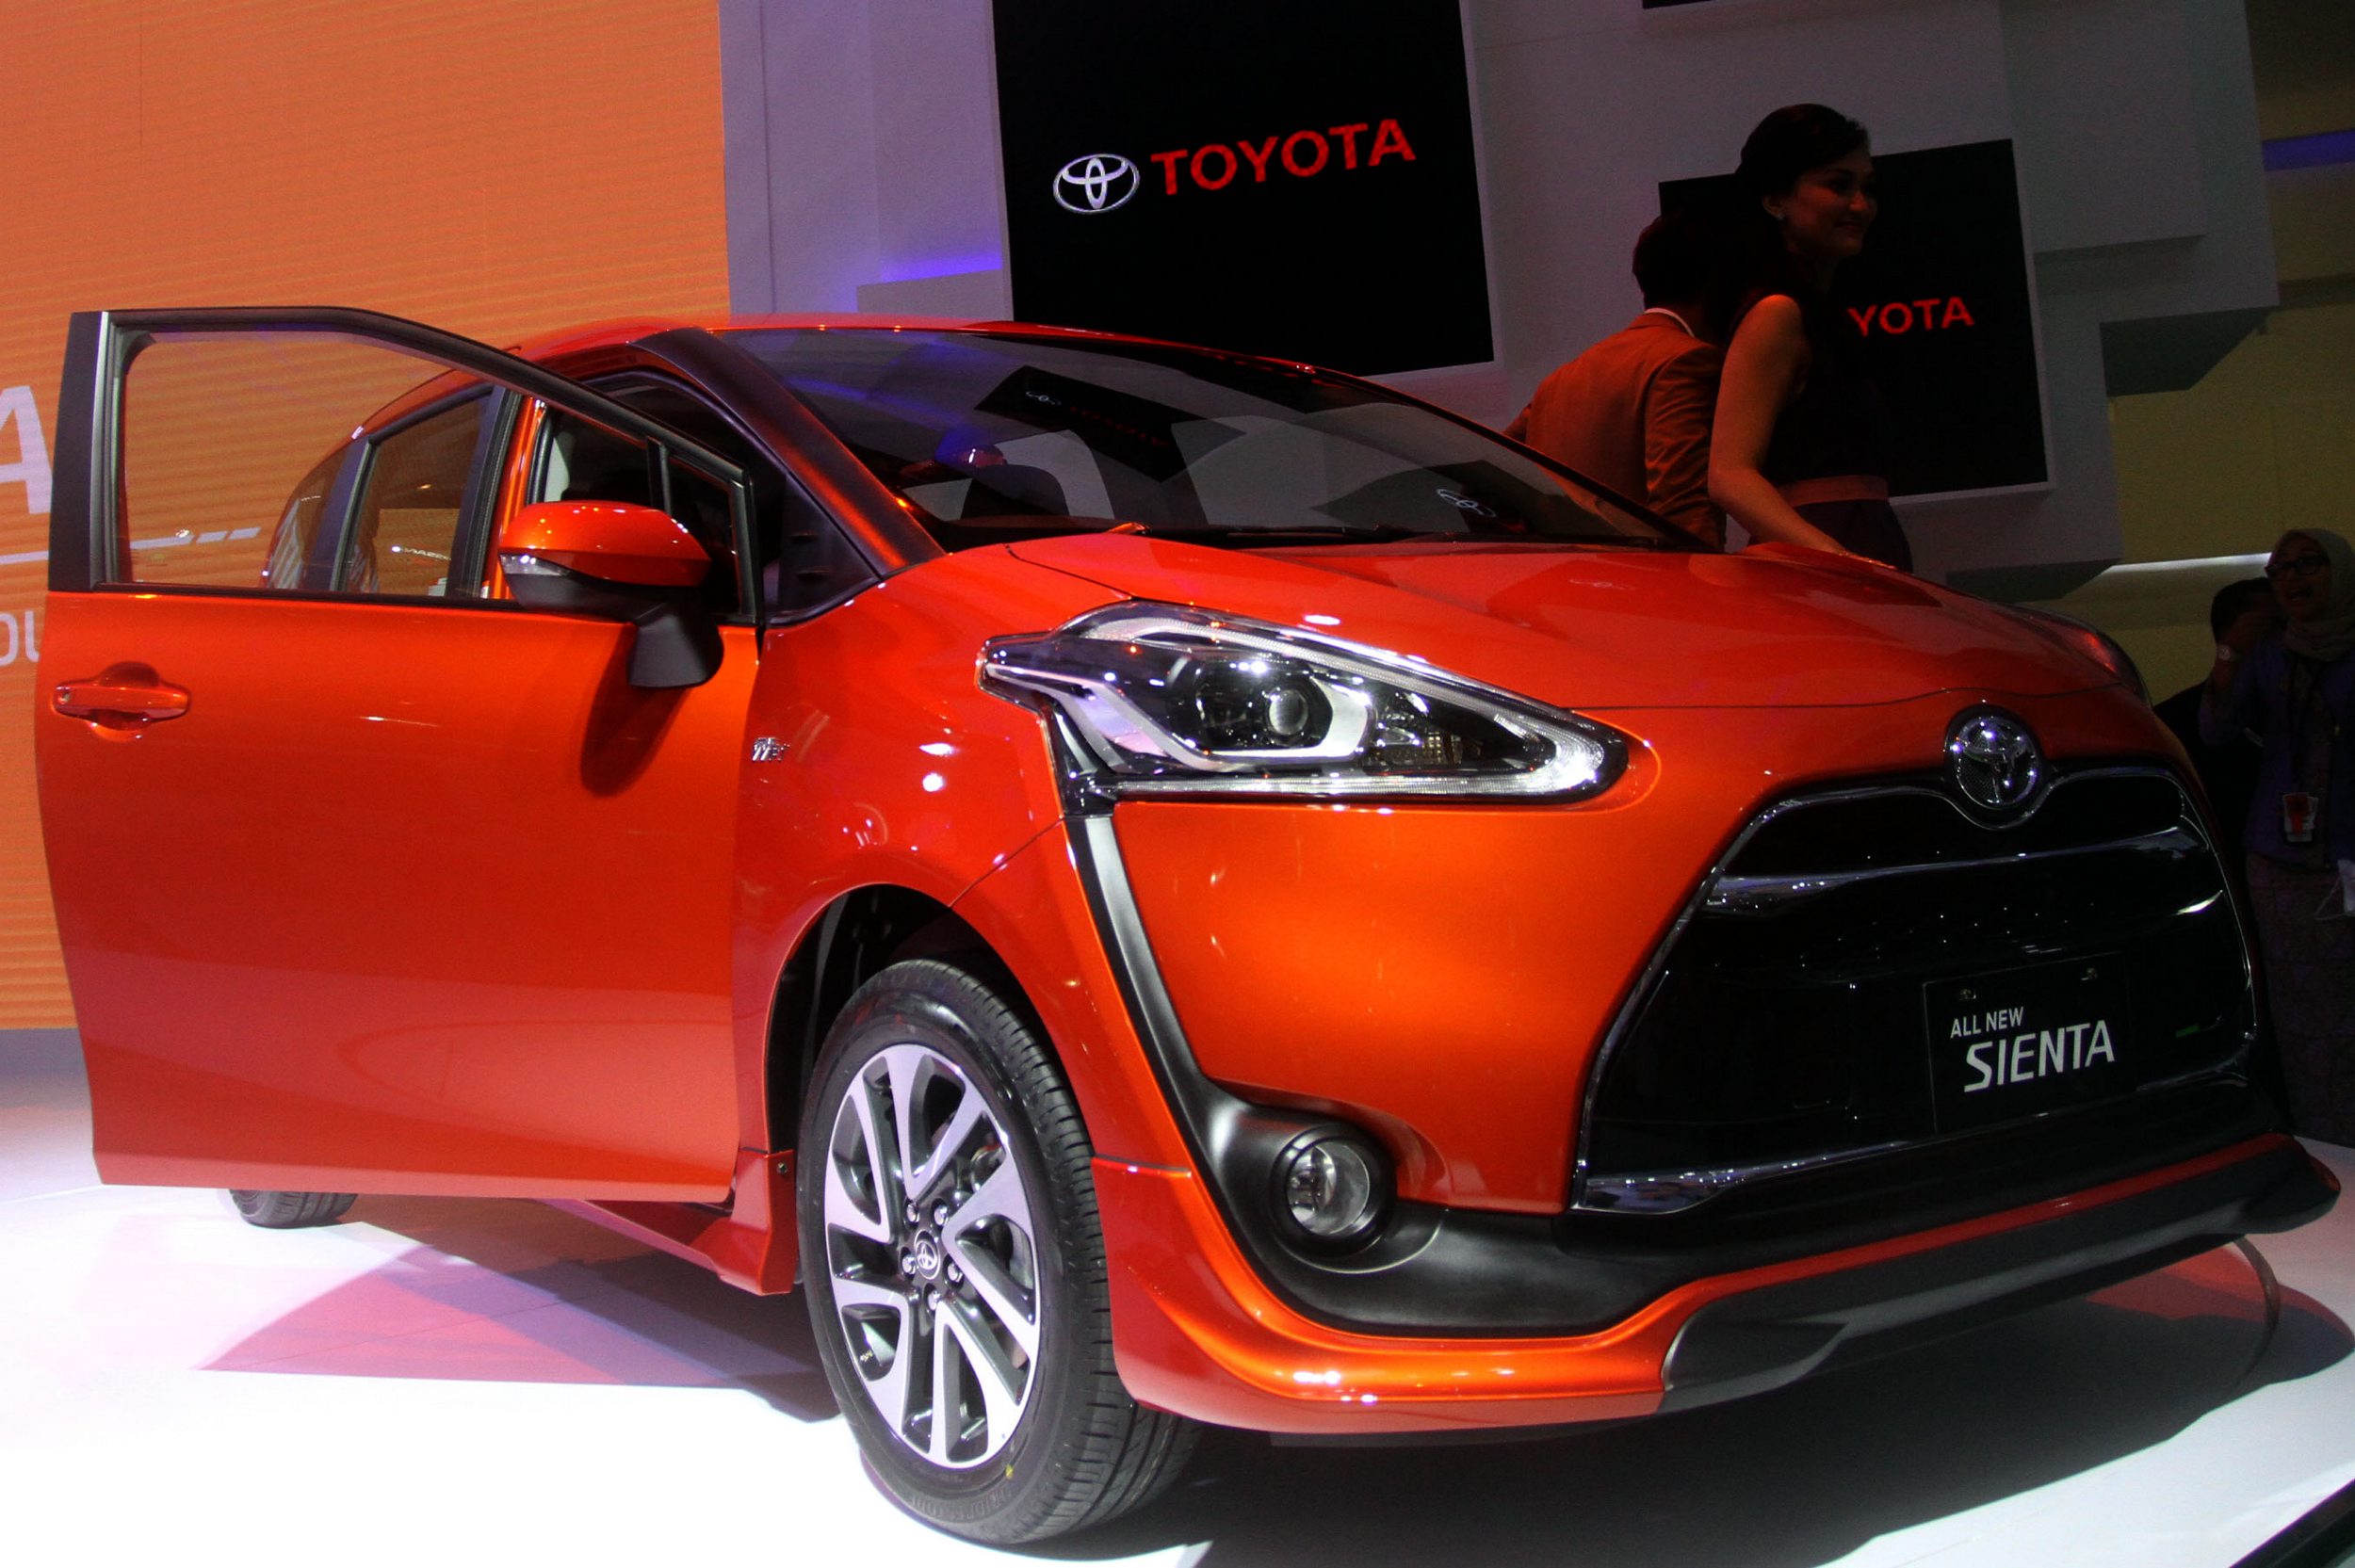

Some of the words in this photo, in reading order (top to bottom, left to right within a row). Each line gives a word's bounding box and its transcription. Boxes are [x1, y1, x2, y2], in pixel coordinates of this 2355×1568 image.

[1149, 118, 1417, 196] TOYOTA
[1950, 1014, 1982, 1039] ALL
[1986, 1006, 2024, 1033] NEW
[1964, 1019, 2116, 1092] SIENTA
